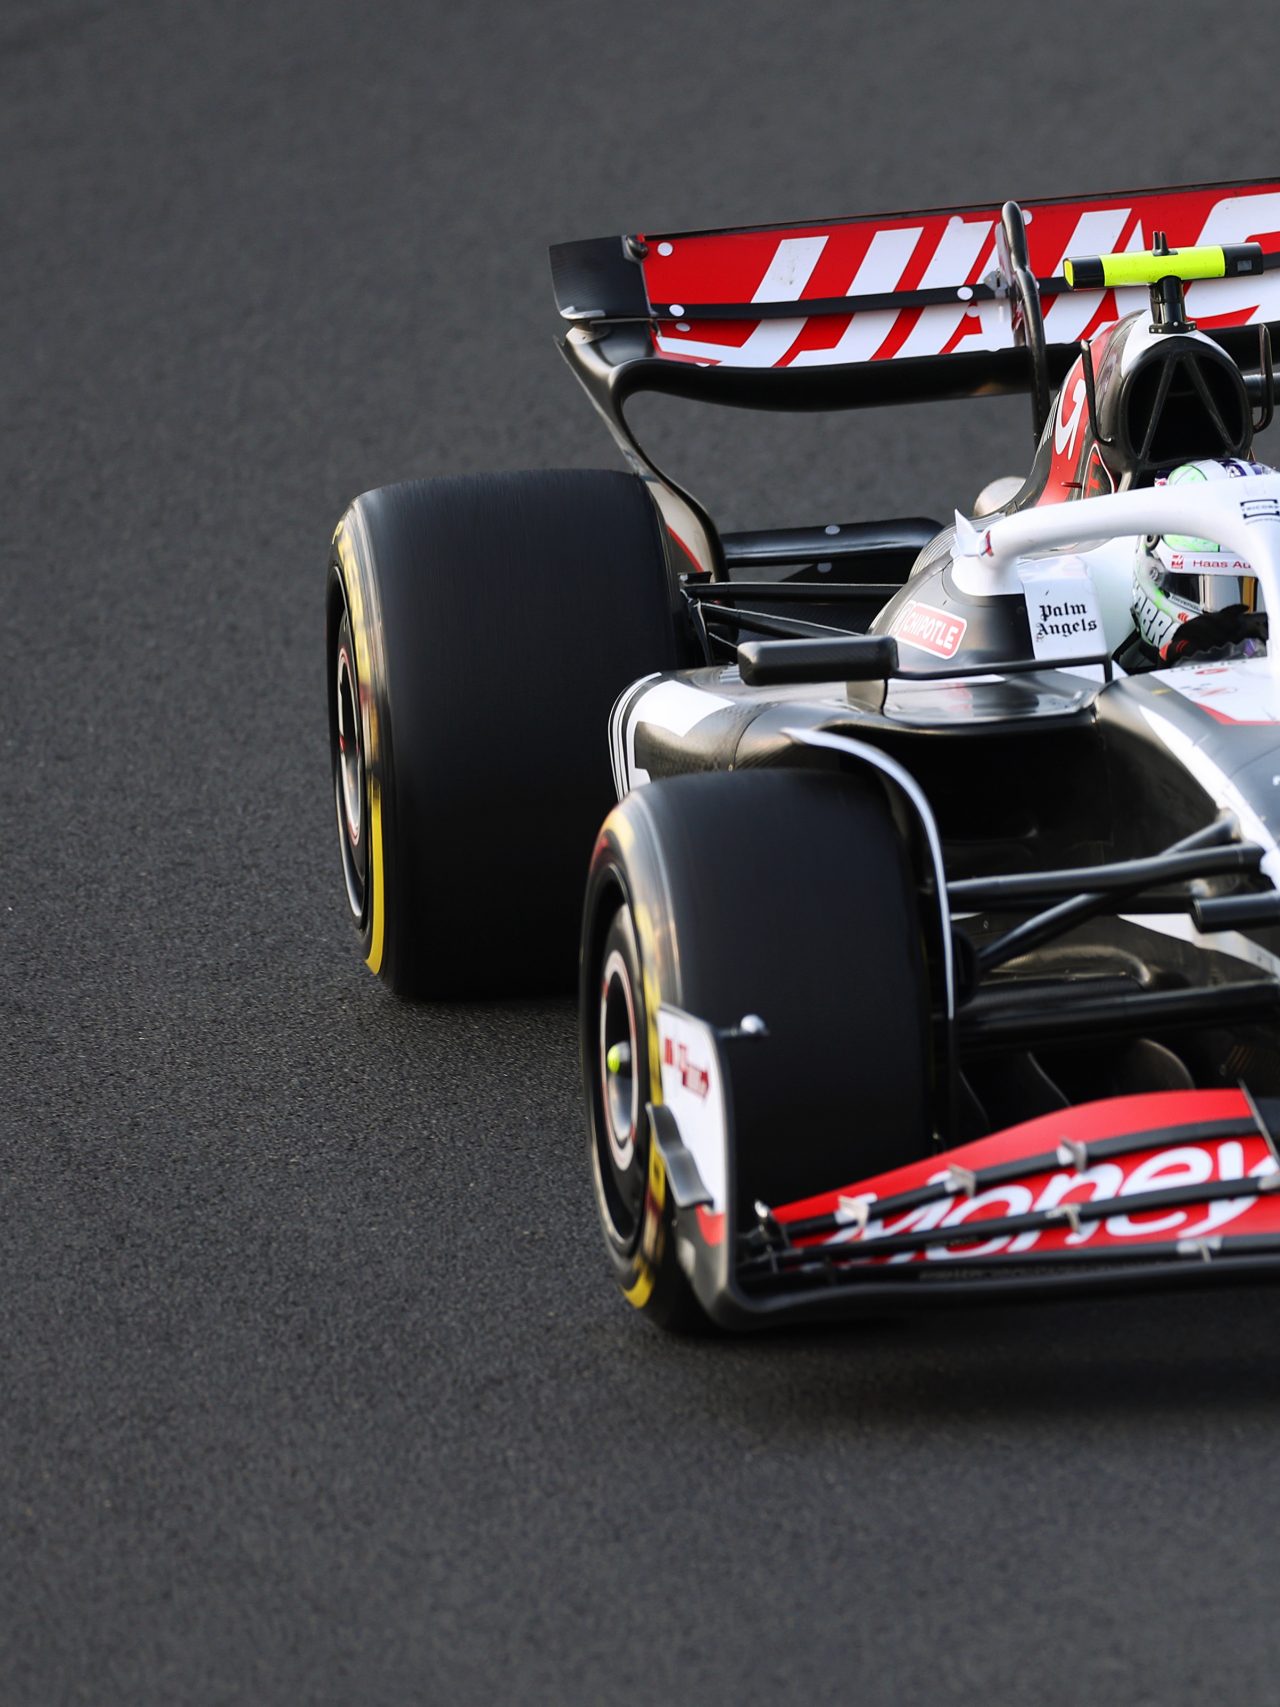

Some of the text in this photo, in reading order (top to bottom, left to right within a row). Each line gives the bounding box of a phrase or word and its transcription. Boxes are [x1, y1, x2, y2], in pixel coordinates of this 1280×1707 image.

[1192, 560, 1228, 569] Haas
[1039, 602, 1087, 622] Palm
[902, 611, 959, 650] CHIPOTLE
[1035, 618, 1098, 642] Angels
